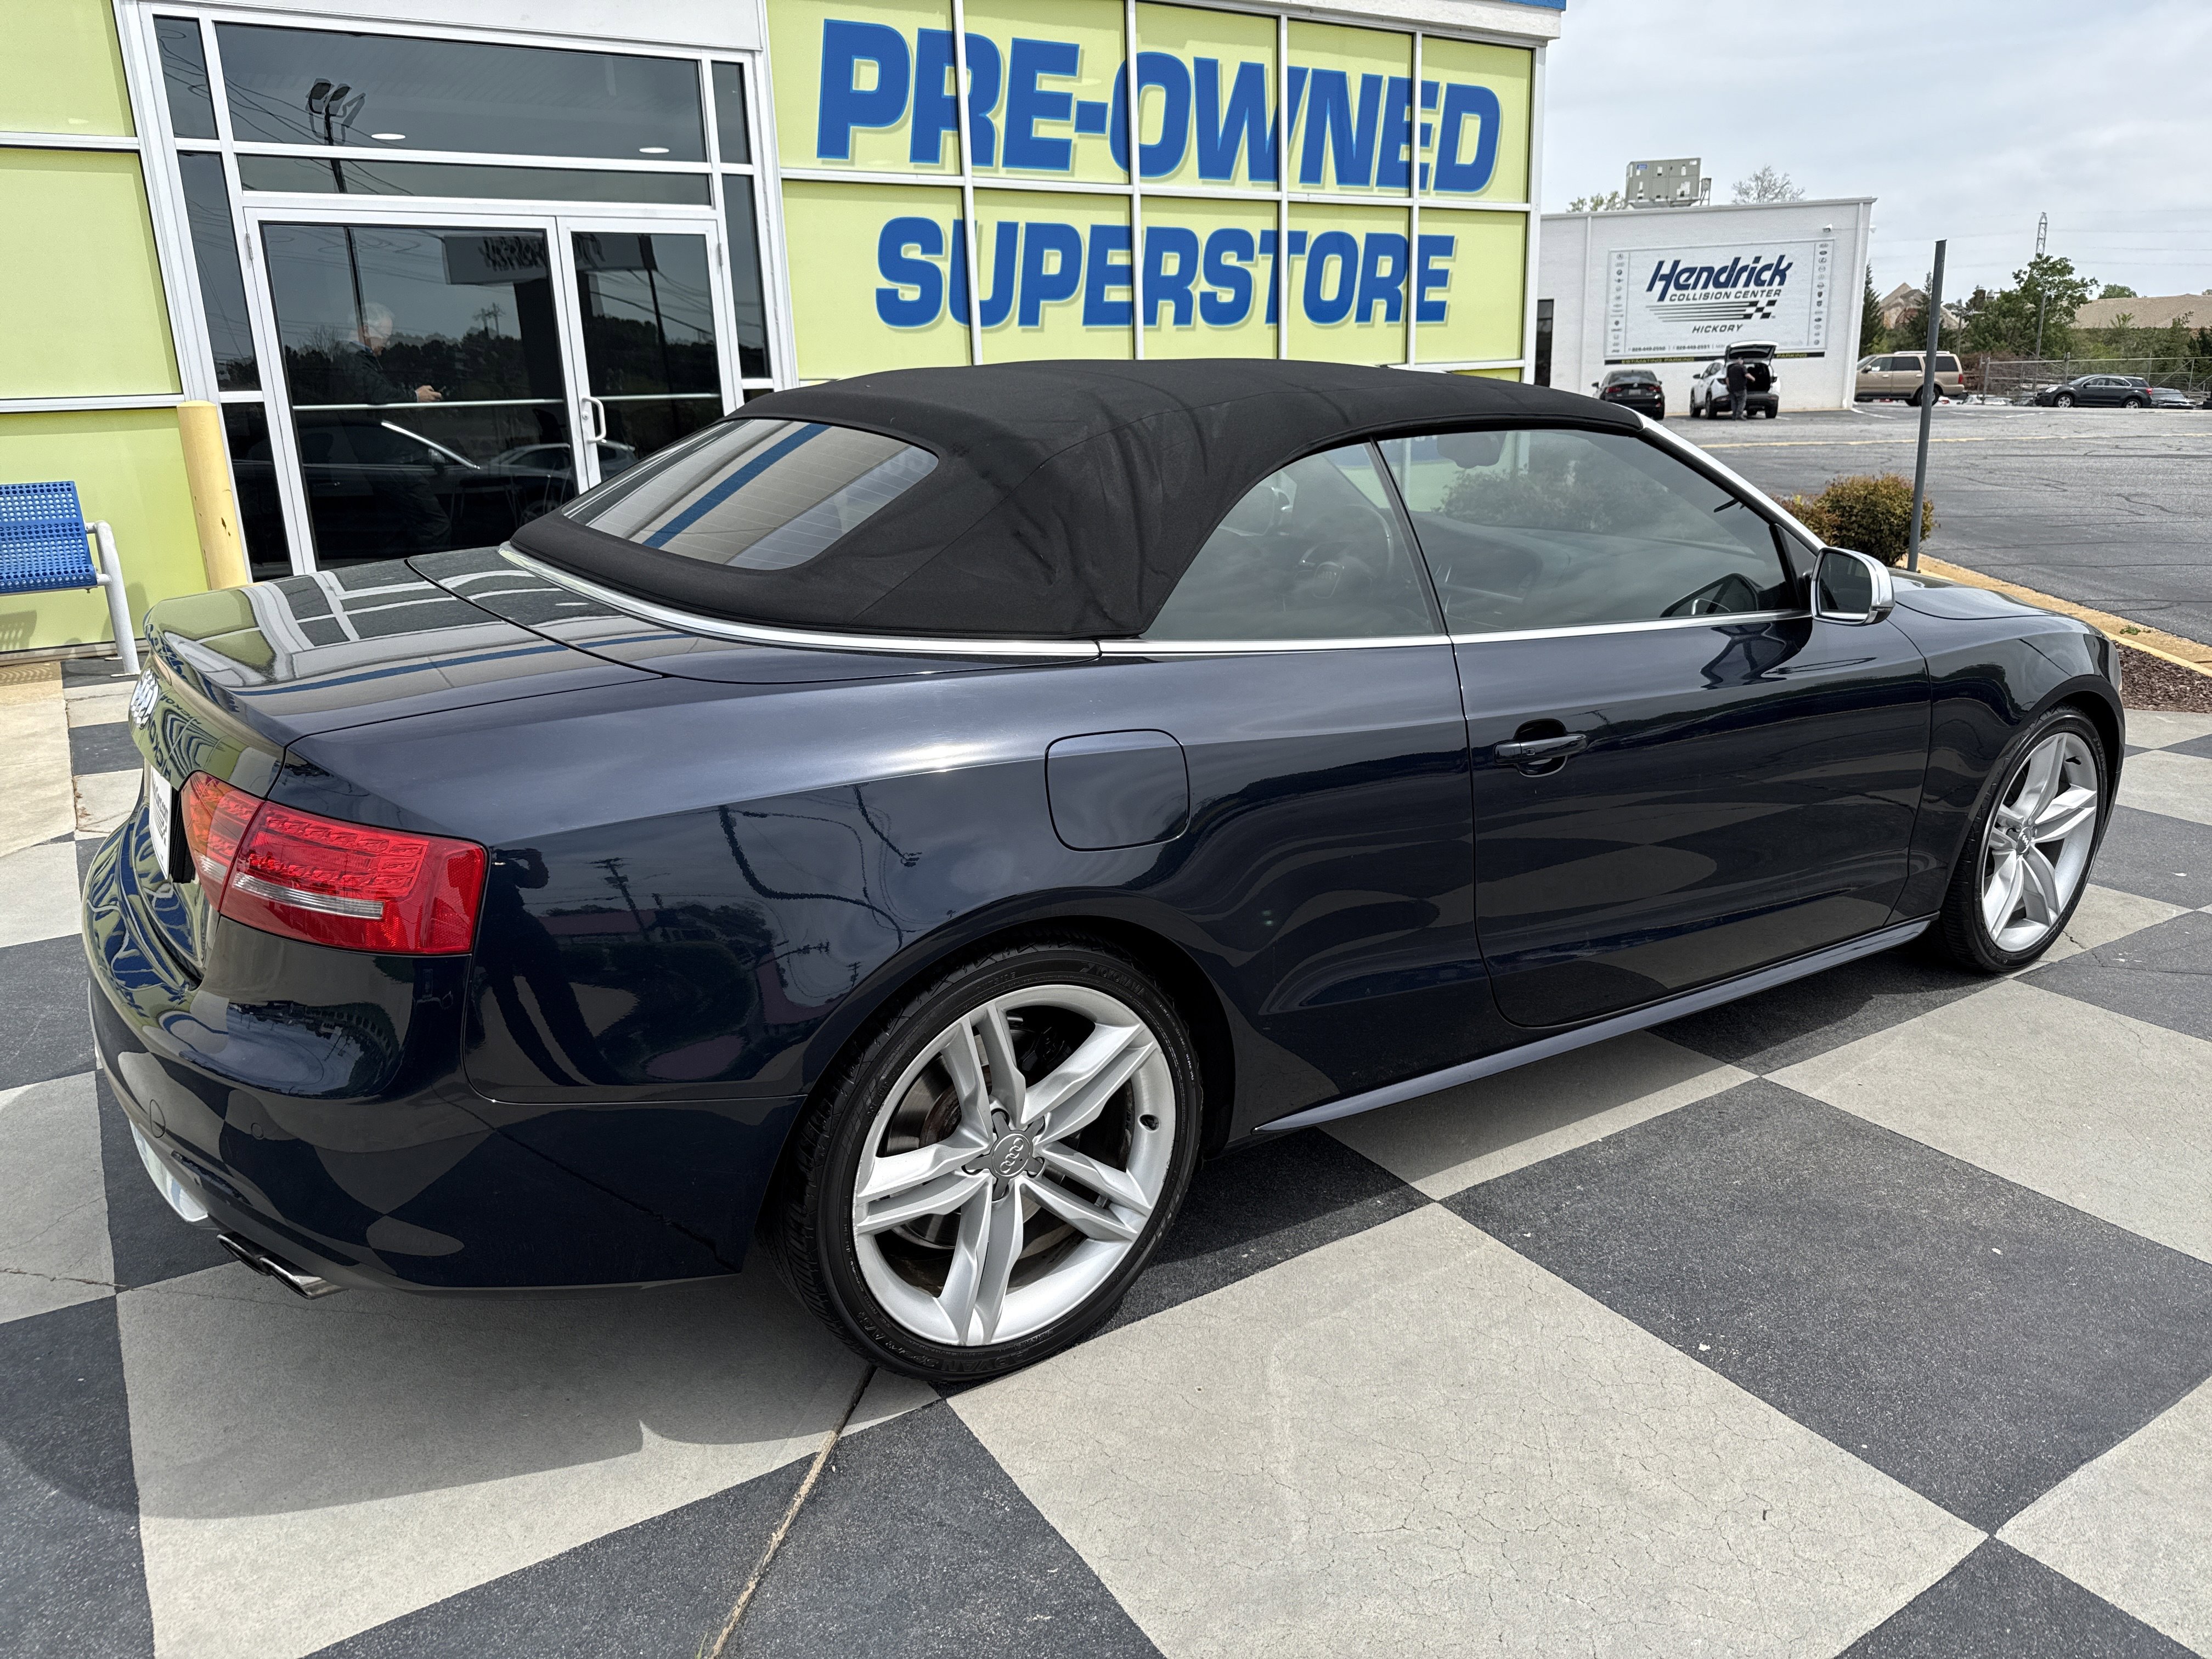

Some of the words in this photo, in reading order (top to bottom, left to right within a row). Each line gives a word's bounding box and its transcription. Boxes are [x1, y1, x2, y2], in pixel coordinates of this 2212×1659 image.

[817, 19, 1501, 194] PRE-OWNED
[875, 216, 1455, 329] SUPERSTORE
[1645, 255, 1793, 302] Hendrick
[1669, 291, 1731, 302] COLLISION
[1734, 289, 1781, 299] CENTER
[1692, 324, 1743, 334] HICKORY
